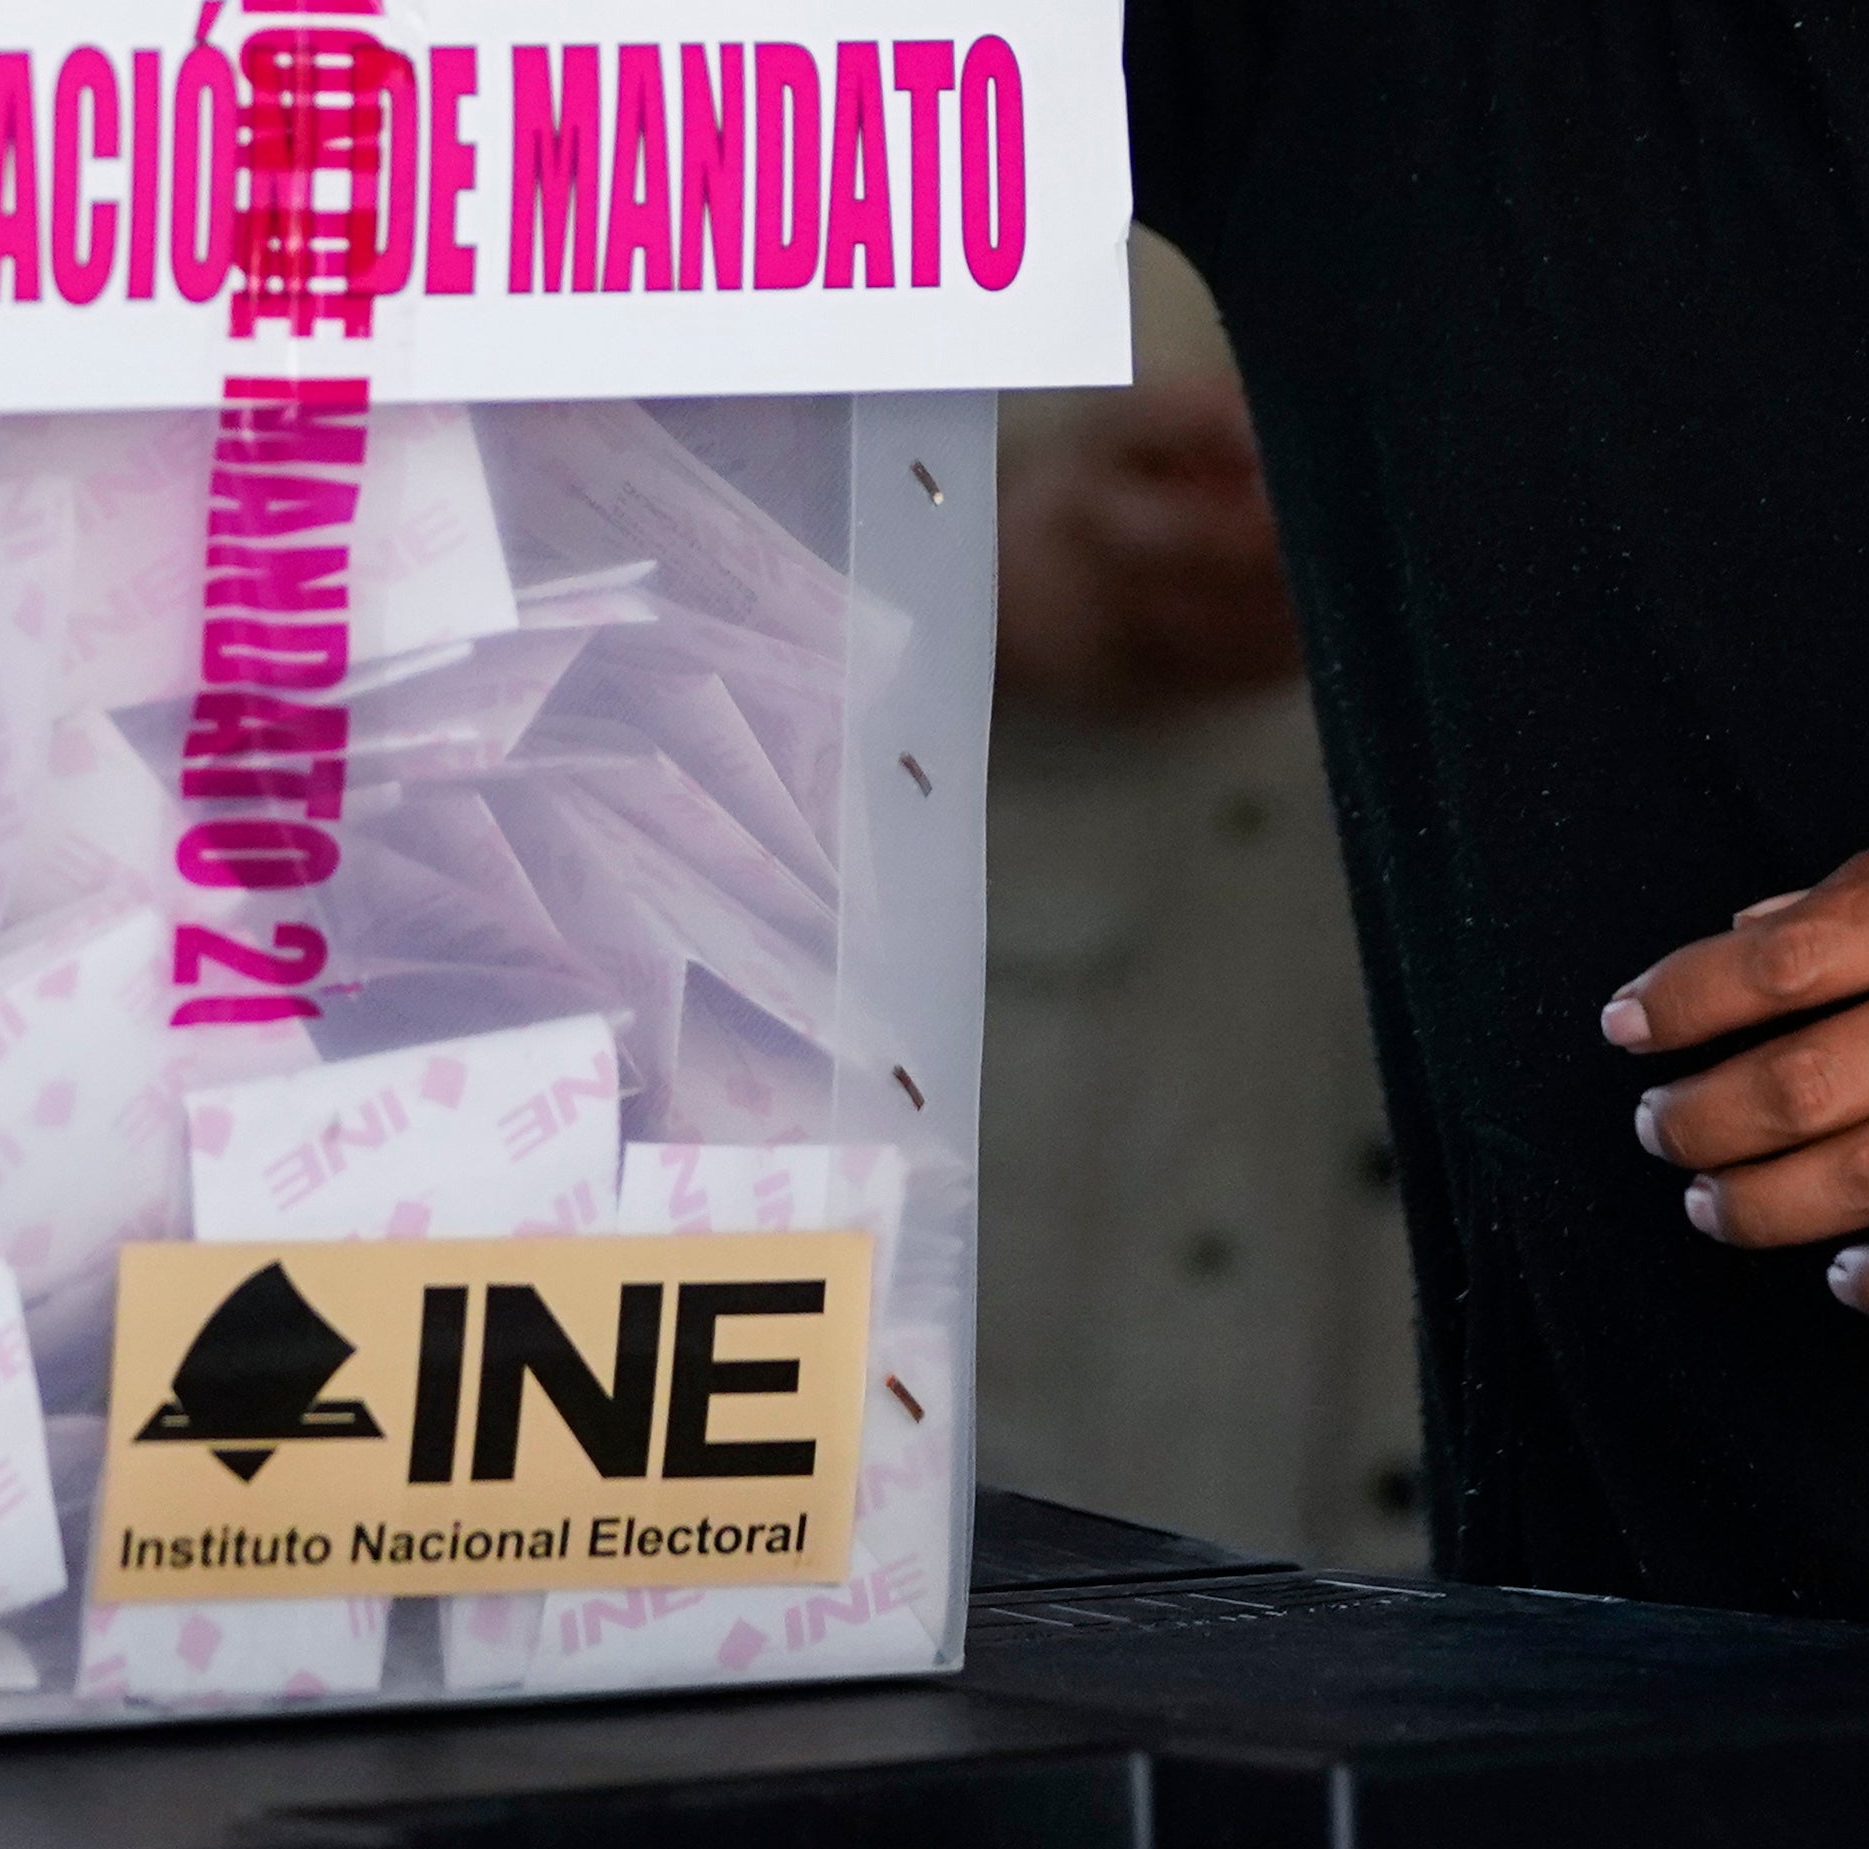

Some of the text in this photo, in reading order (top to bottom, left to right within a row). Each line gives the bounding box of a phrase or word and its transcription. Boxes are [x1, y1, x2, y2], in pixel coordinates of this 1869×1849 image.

[348, 45, 478, 296] DE
[507, 33, 1027, 294] MANDATO
[174, 377, 371, 890] MANDATO
[263, 1087, 412, 1213] INE
[407, 1278, 827, 1485] INE
[119, 1511, 811, 1571] Instituto Nacional Electoral
[784, 1553, 928, 1651] INE
